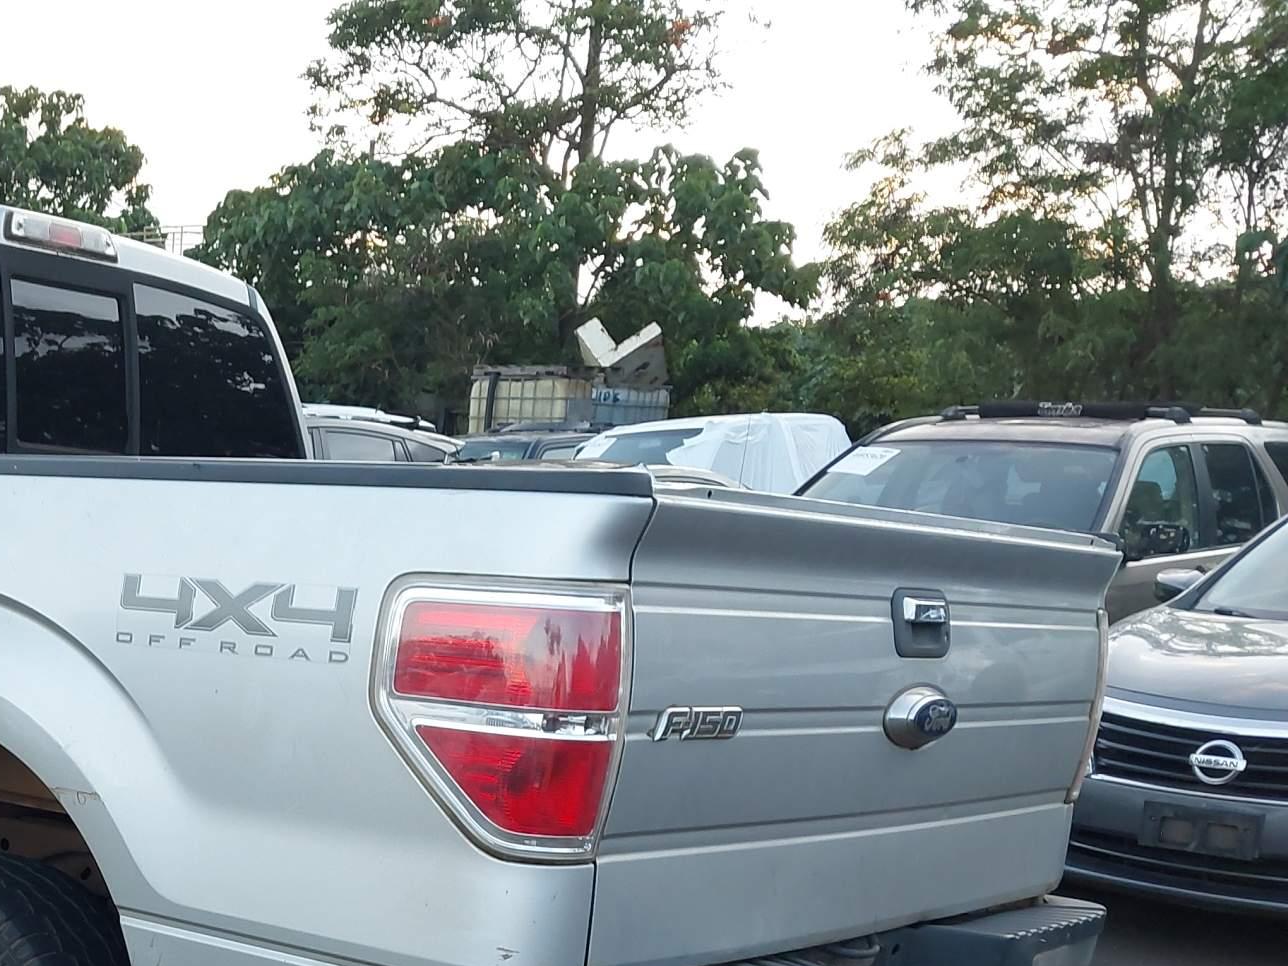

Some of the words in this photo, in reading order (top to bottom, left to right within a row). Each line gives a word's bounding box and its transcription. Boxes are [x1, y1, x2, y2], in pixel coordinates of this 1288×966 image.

[120, 573, 358, 643] 4X4
[116, 632, 196, 649] OFF
[219, 640, 349, 663] ROAD
[1193, 756, 1240, 769] NISSAN
